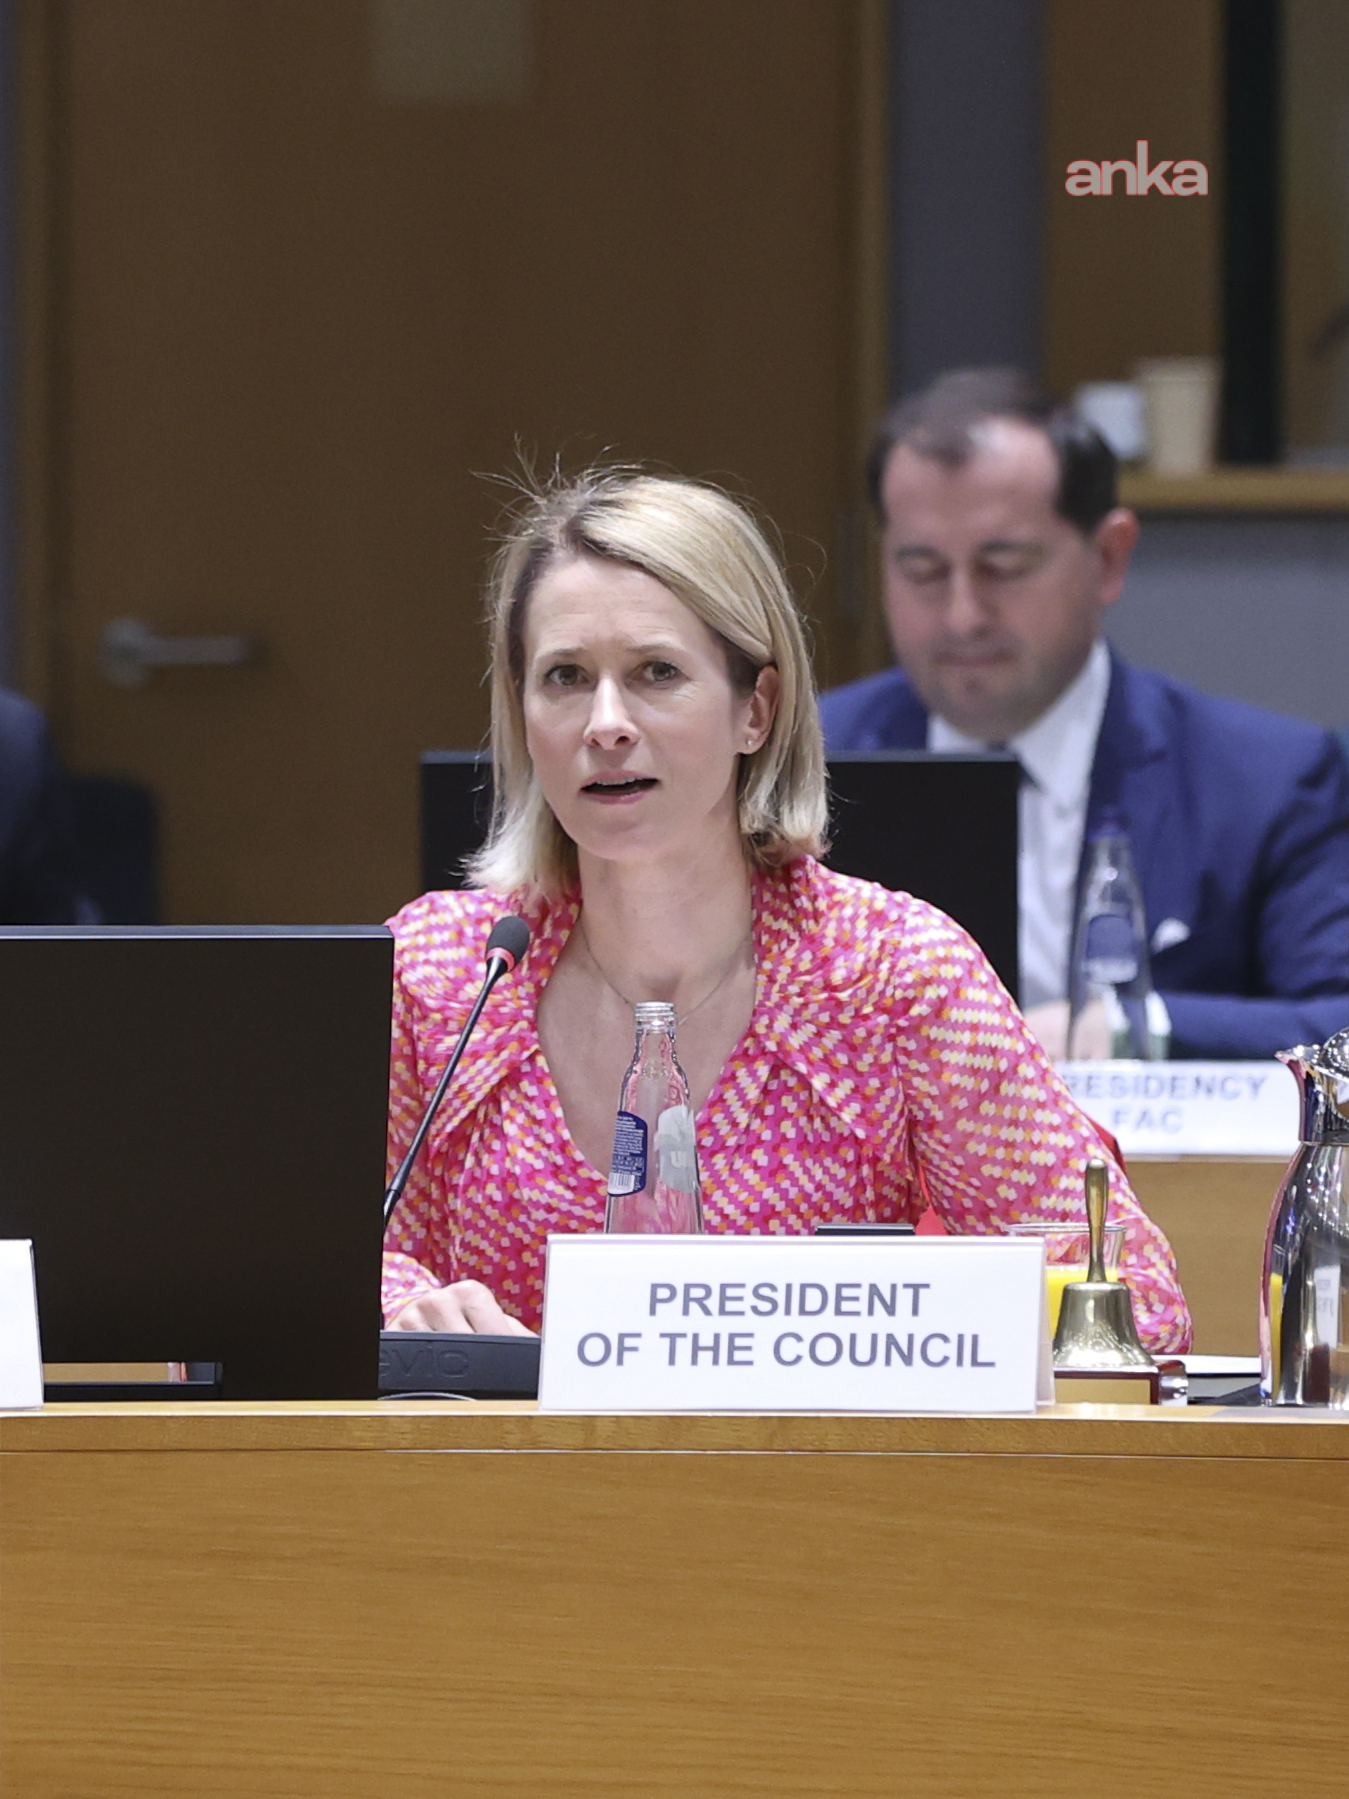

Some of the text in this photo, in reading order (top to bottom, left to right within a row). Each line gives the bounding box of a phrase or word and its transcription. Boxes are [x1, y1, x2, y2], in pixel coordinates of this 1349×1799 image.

[1061, 1073, 1268, 1101] RESIDENCY
[1112, 1105, 1184, 1134] FAC
[648, 1282, 931, 1317] PRESIDENT
[576, 1332, 996, 1368] OF THE COUNCIL
